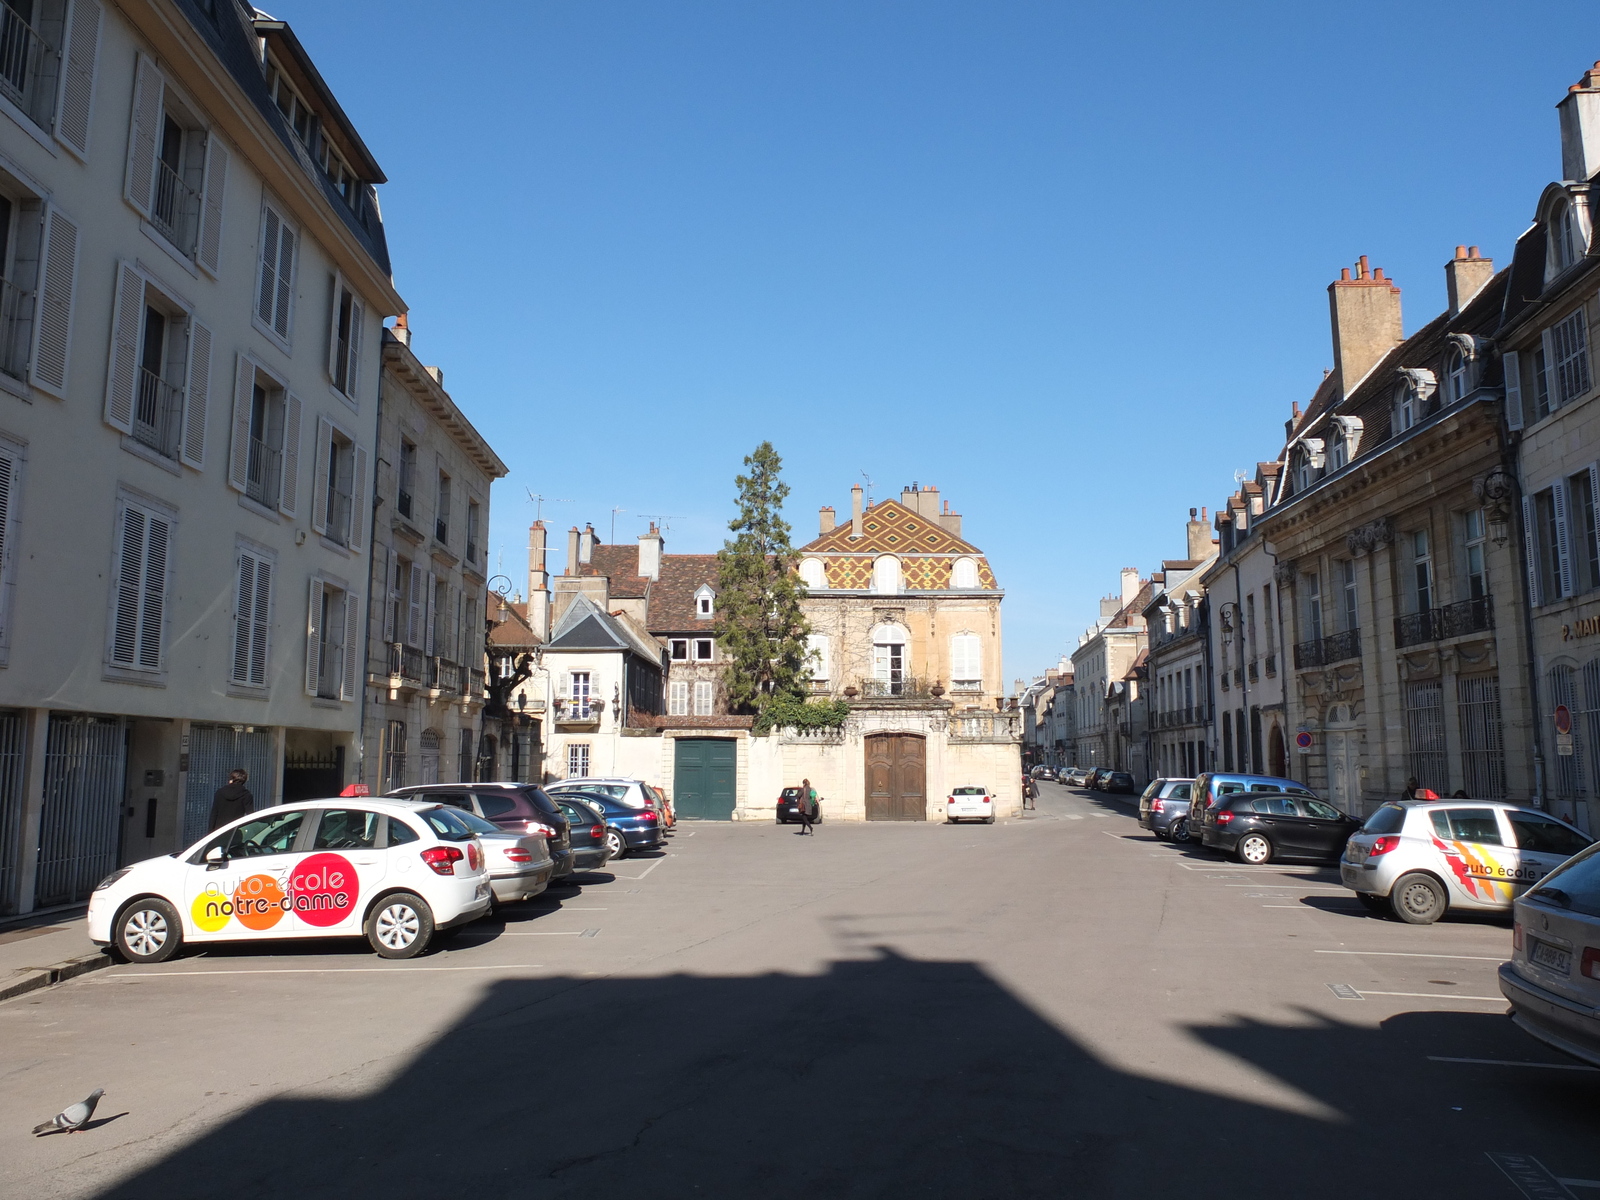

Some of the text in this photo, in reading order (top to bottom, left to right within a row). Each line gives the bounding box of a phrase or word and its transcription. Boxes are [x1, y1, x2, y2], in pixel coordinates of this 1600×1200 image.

[205, 866, 345, 896] auto-école
[1462, 863, 1493, 875] auto
[1498, 864, 1536, 879] école
[206, 889, 349, 917] notre-dame
